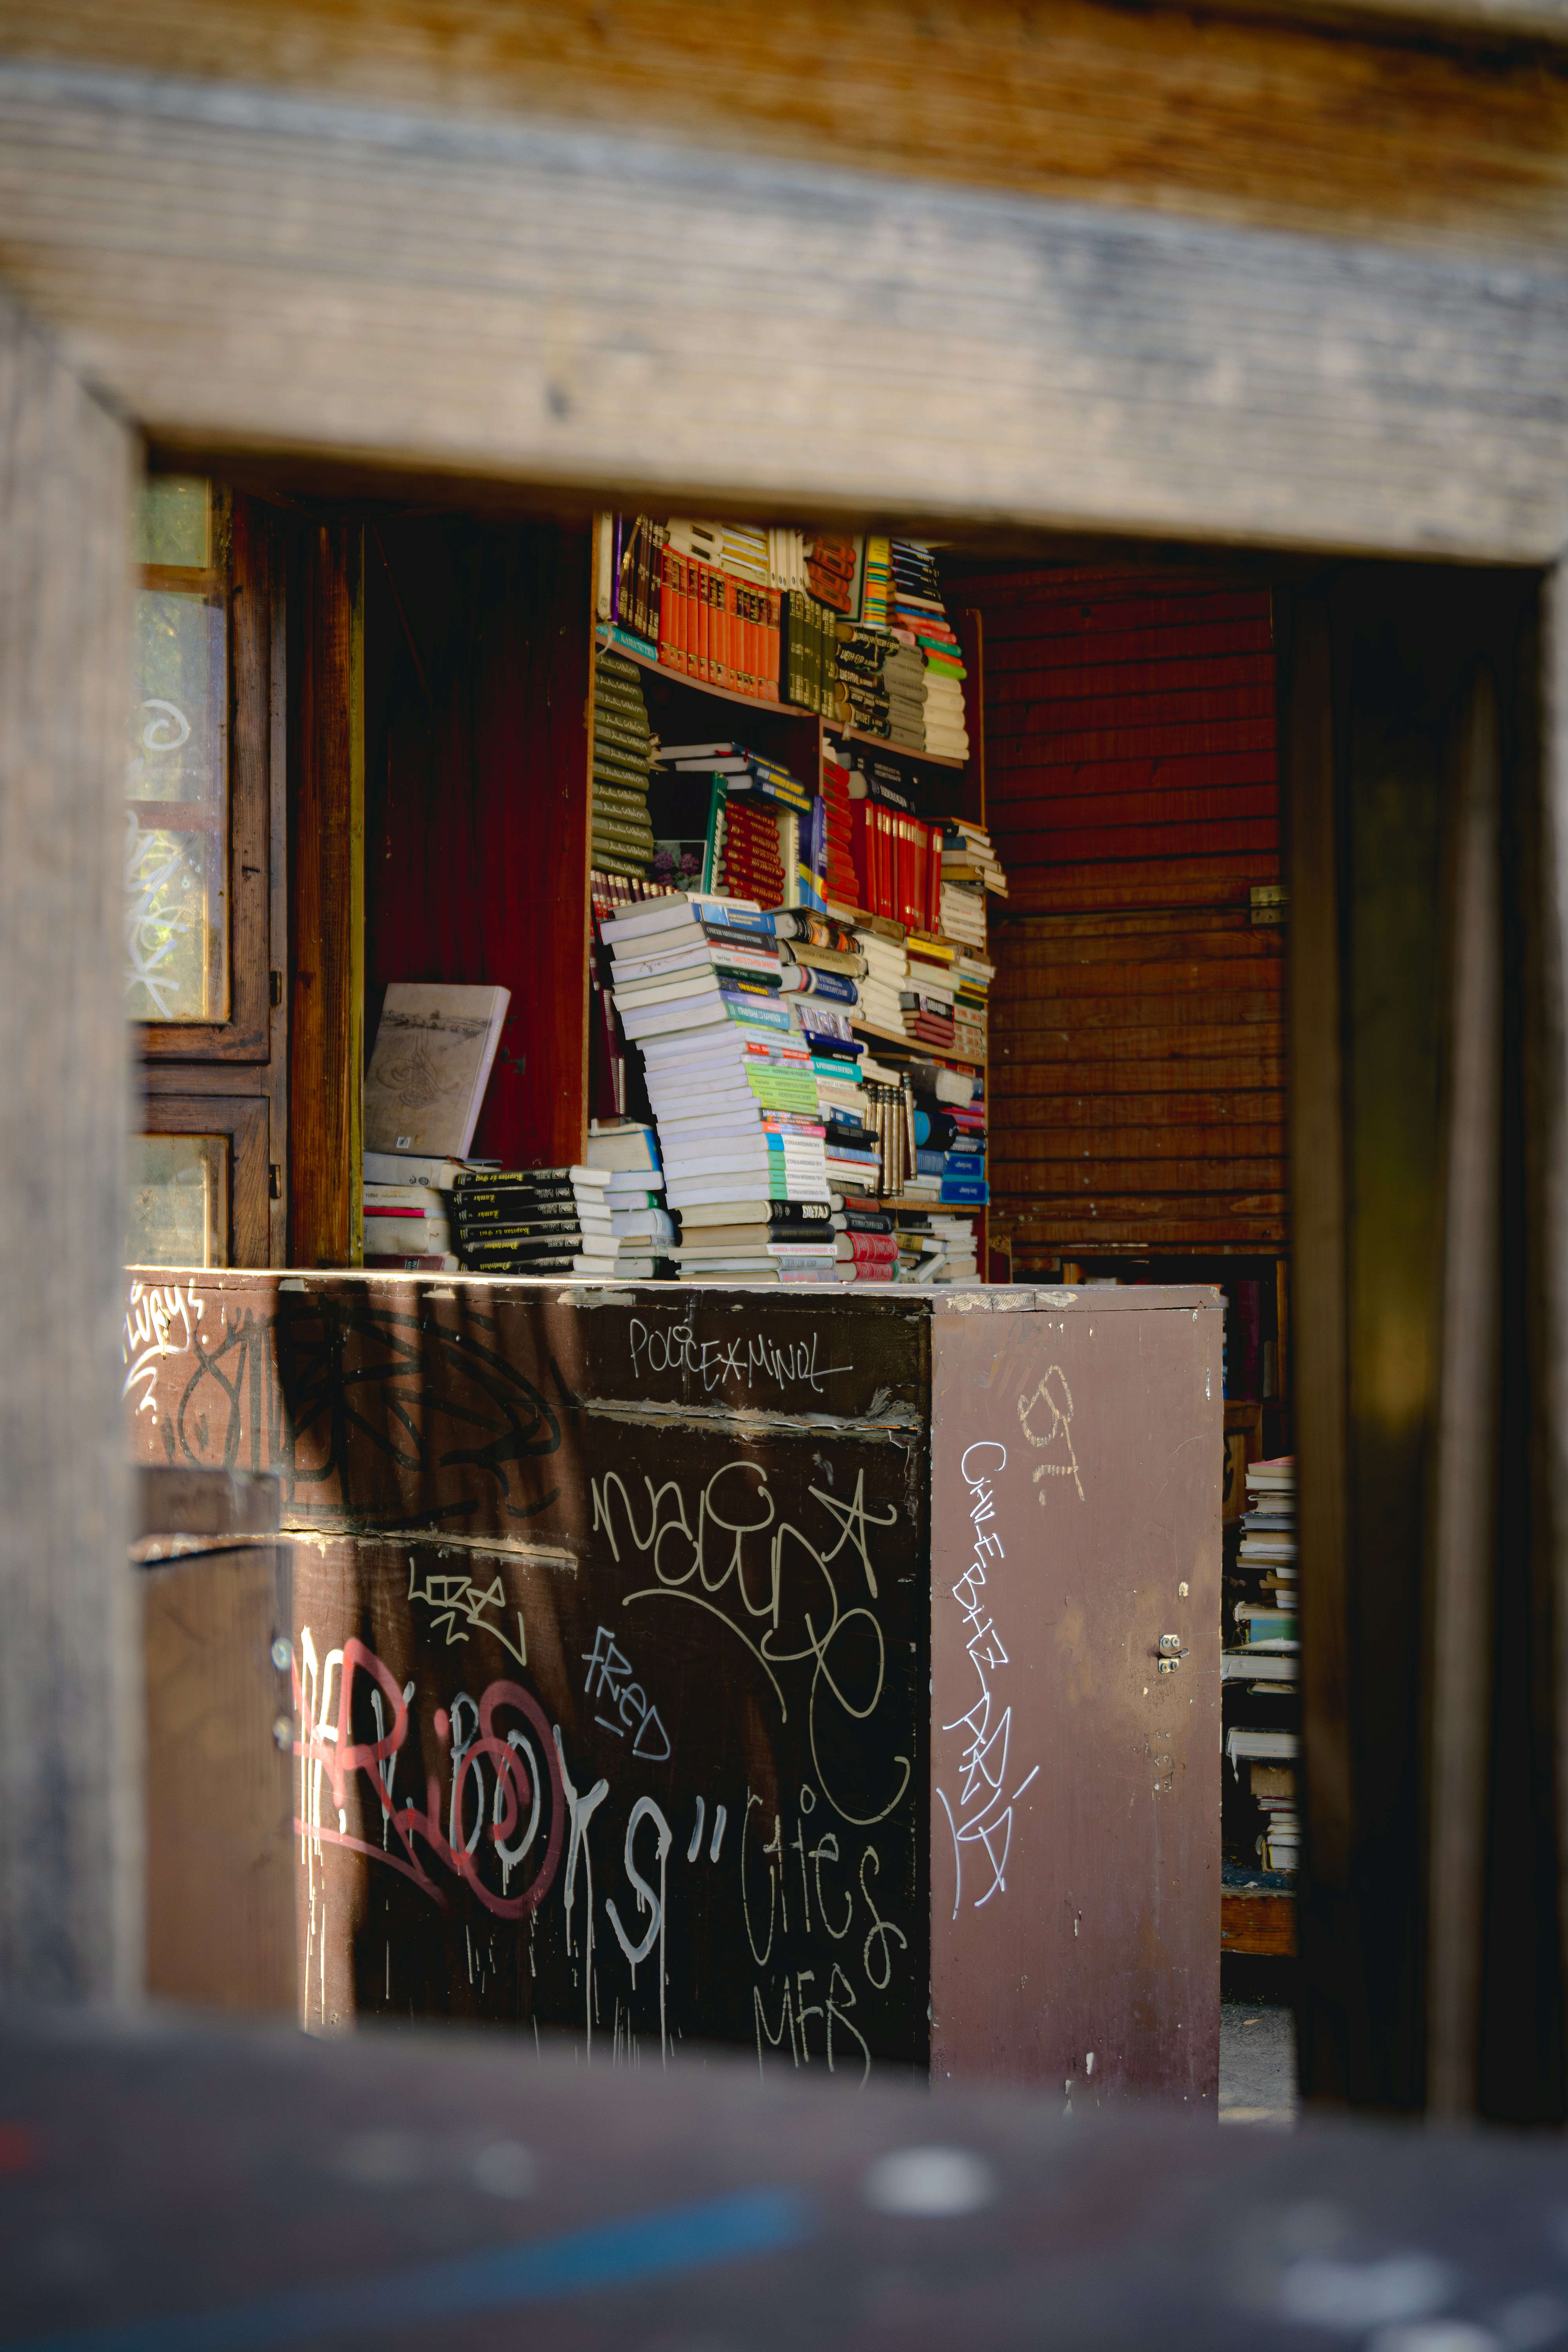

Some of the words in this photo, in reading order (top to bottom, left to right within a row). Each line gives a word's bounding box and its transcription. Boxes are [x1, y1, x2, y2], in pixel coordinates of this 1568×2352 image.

[621, 633, 637, 650] KAMA
[637, 641, 654, 658] SUTRA
[855, 711, 870, 724] ВИЛЕТ
[880, 785, 907, 808] FIZIOLOGIJA
[736, 1006, 759, 1019] УПРАВУВАЊЕ
[759, 1011, 763, 1019] СО
[815, 1062, 853, 1075] КРИМИНОЛОГИЈА
[802, 1205, 829, 1219] DILTAJ
